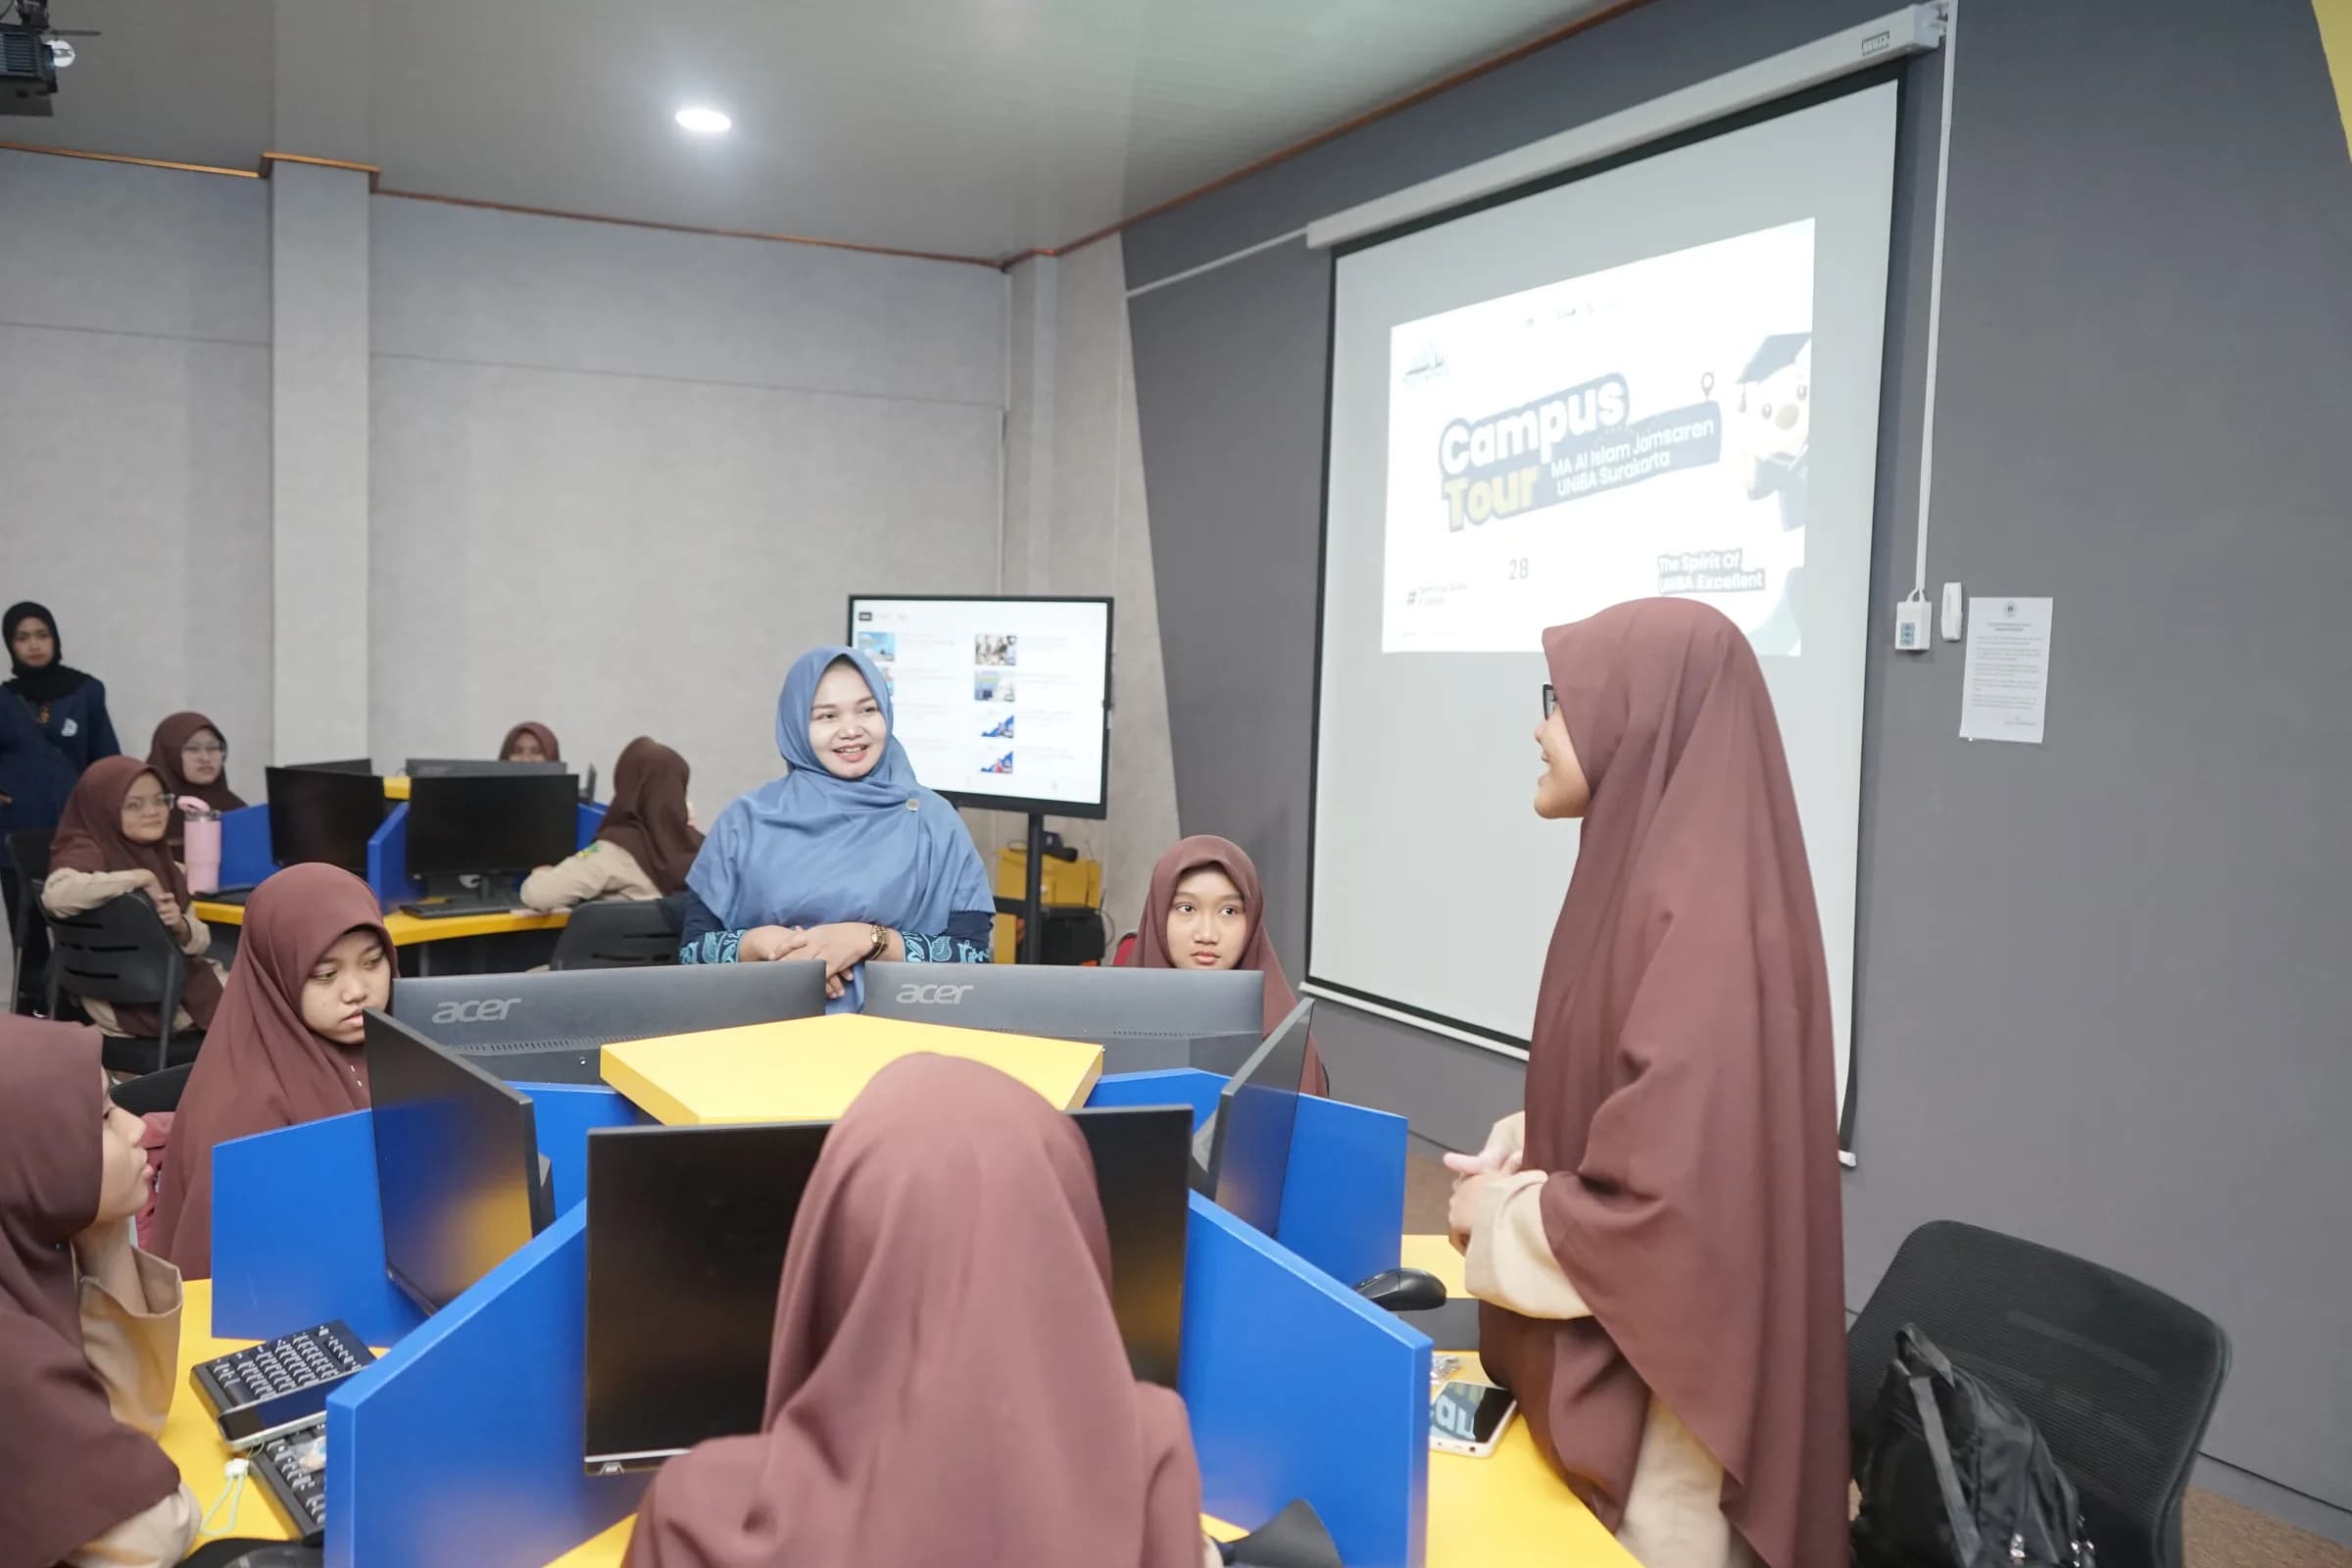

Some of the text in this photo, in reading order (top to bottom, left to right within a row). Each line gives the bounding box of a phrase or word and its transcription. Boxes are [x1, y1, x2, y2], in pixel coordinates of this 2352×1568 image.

[1442, 381, 1627, 476] Campus
[1550, 457, 1573, 478] MA
[1591, 441, 1631, 467] Islam
[1633, 418, 1714, 455] Jamsaren
[1556, 450, 1671, 496] UNIBA Surakarta
[1445, 466, 1540, 530] Tour
[1508, 558, 1529, 580] 28
[1659, 551, 1740, 573] The Spirit Of
[1696, 571, 1762, 589] Excellent
[896, 983, 974, 1004] acer
[431, 998, 521, 1024] acer
